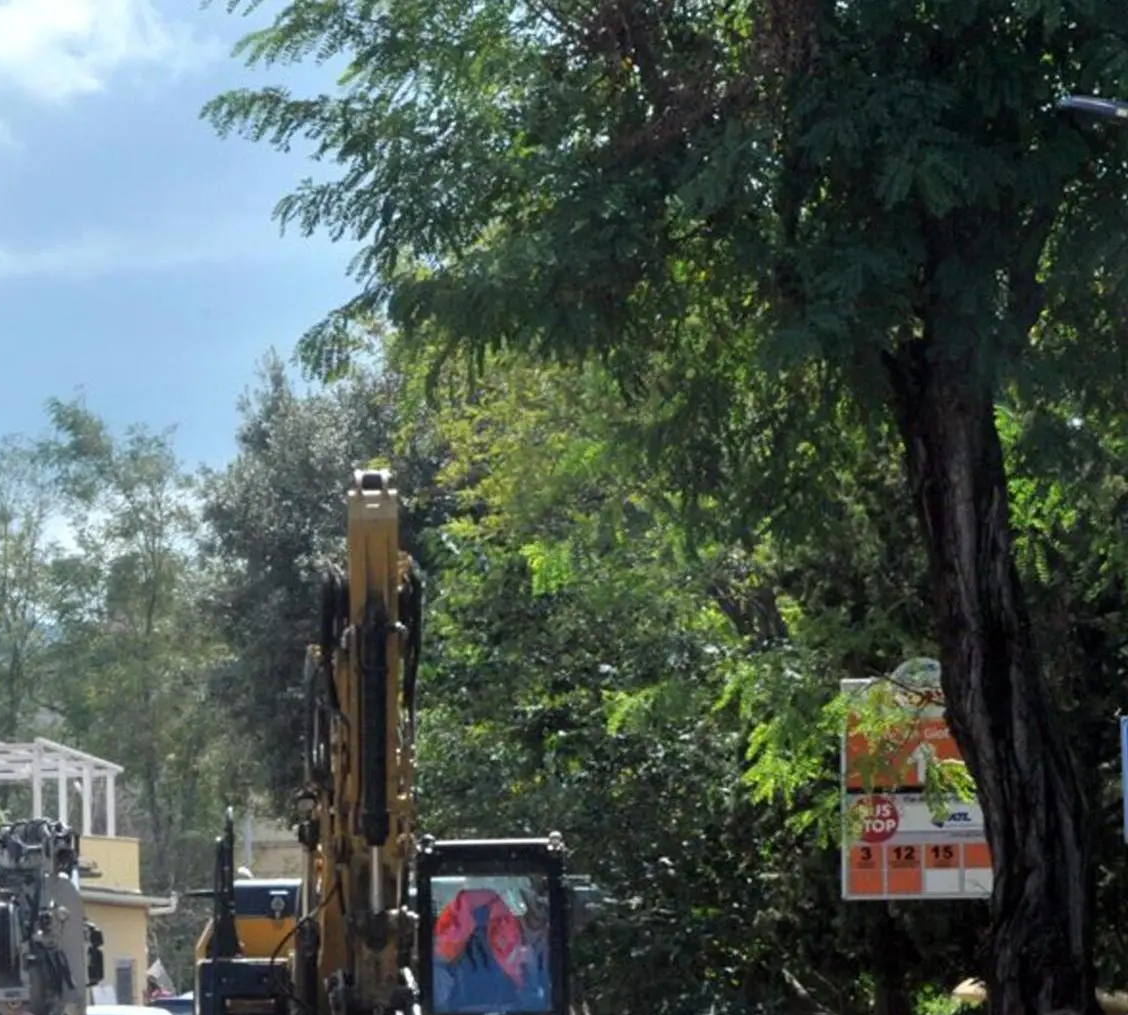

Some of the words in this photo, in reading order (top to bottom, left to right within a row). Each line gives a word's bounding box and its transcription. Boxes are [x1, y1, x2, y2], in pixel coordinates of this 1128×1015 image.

[860, 847, 872, 861] 3
[893, 846, 915, 860] 12
[931, 845, 954, 859] 15
